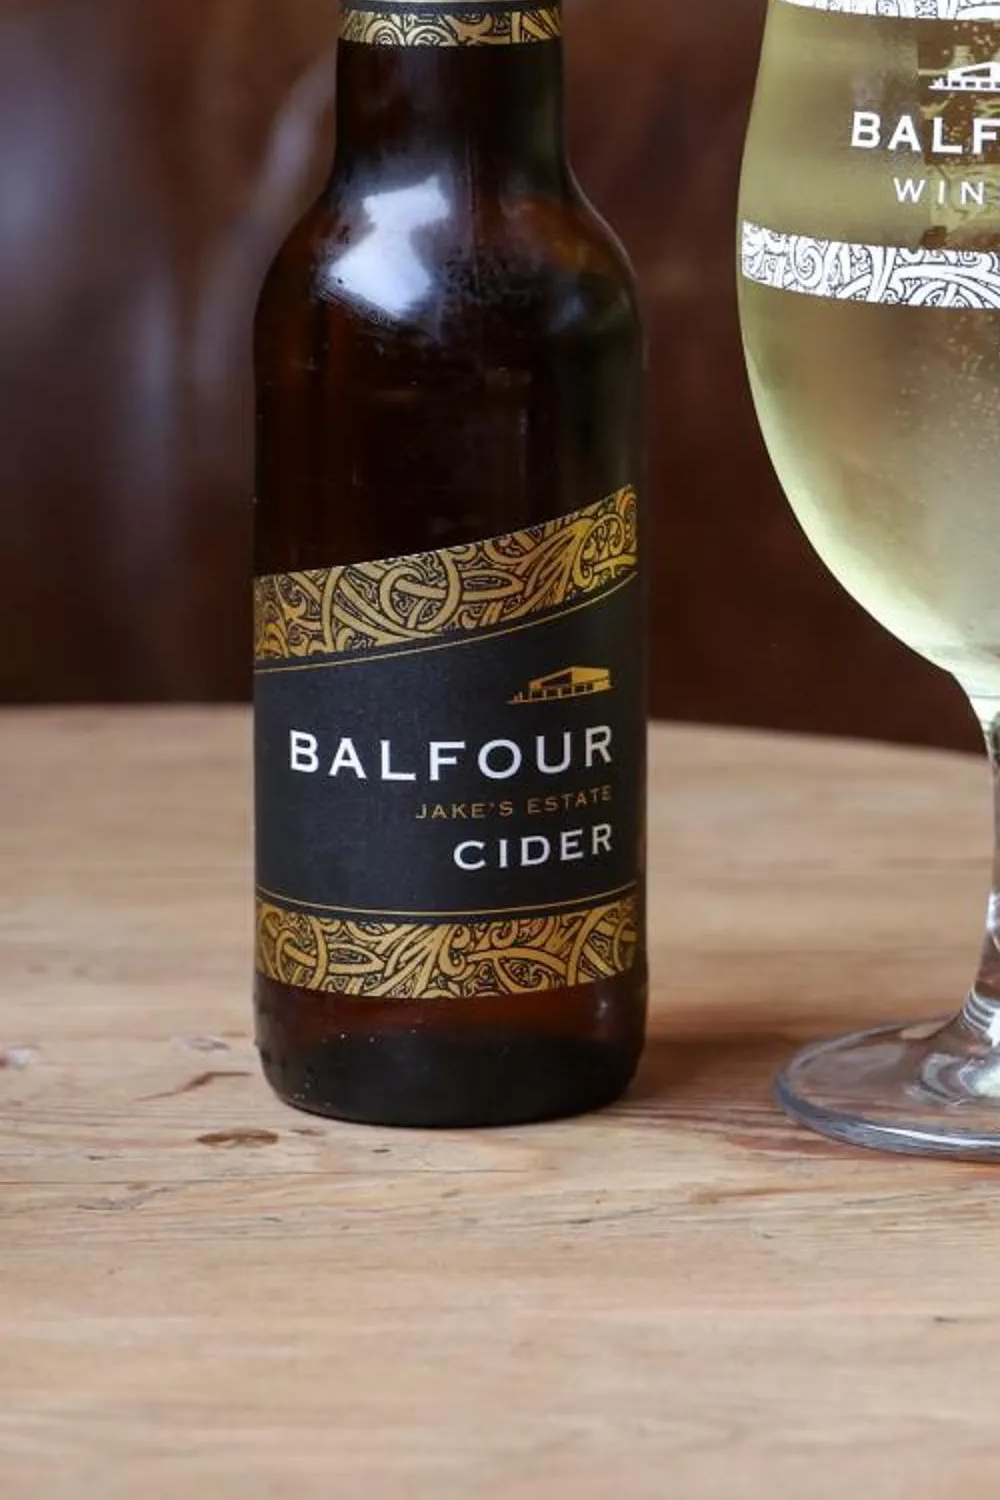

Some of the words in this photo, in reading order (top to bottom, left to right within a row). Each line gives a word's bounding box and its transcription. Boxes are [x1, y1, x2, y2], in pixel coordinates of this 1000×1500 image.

[289, 724, 613, 781] BALFOUR
[415, 801, 514, 819] JAKE'S
[527, 784, 613, 815] ESTATE
[453, 822, 613, 870] CIDER
